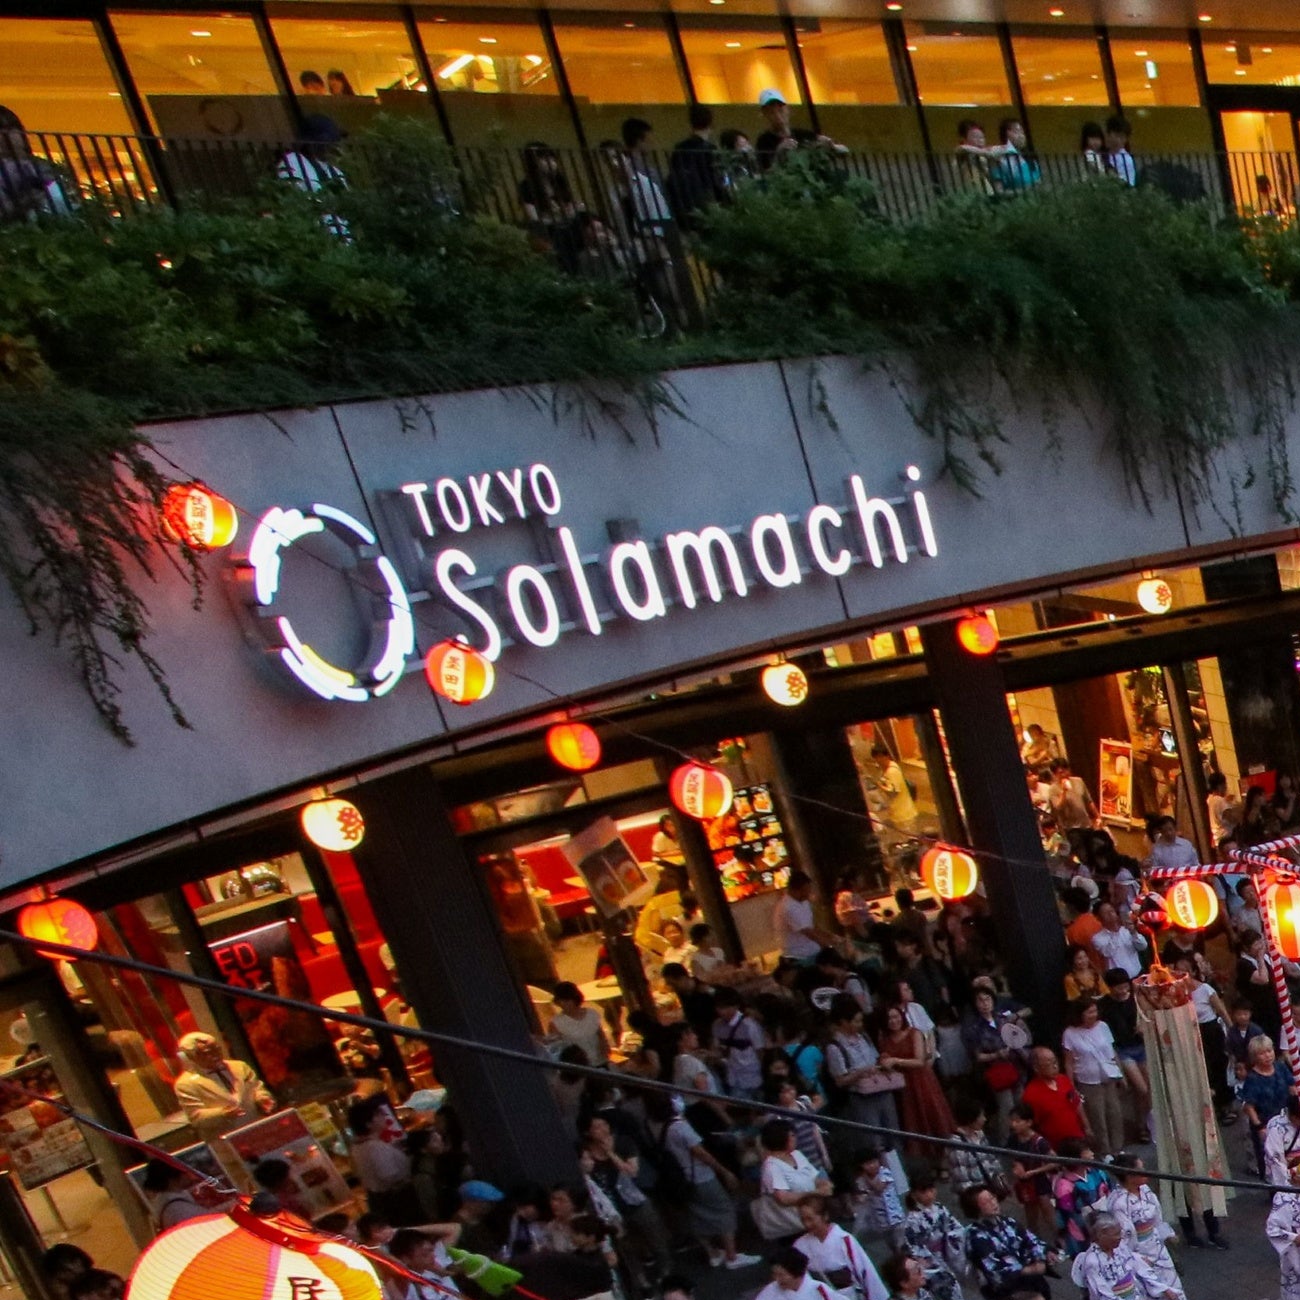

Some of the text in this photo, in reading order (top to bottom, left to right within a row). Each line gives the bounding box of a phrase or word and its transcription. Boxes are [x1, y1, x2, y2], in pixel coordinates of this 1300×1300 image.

[402, 463, 562, 537] TOKYO
[436, 465, 940, 662] Solamachi
[786, 671, 807, 699] 祭
[337, 806, 365, 842] 祭
